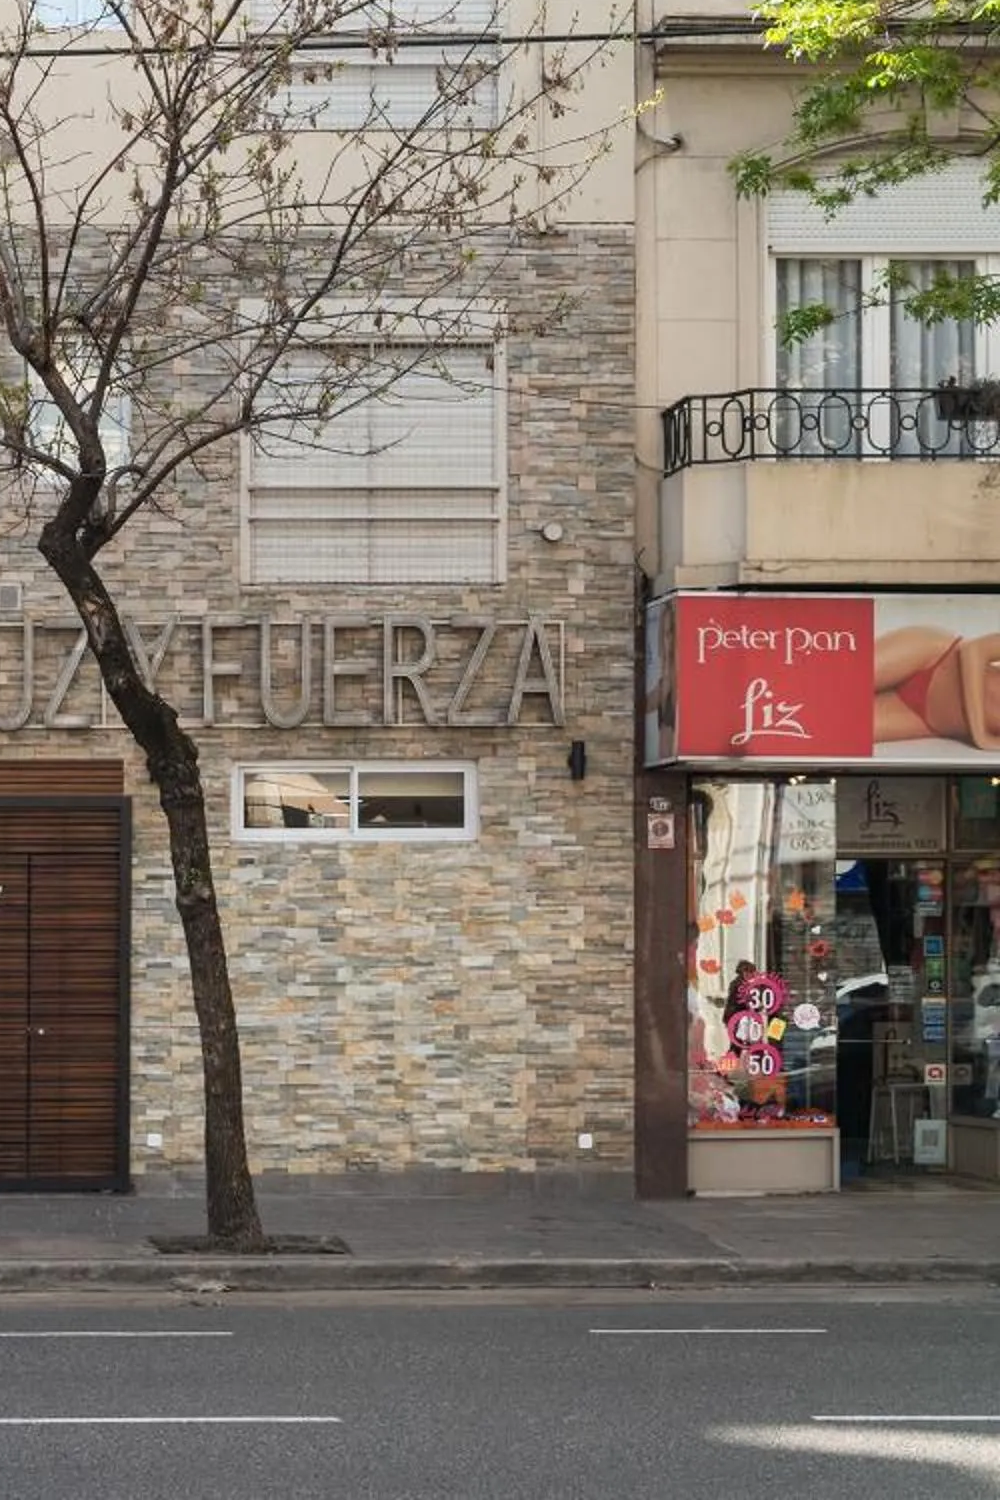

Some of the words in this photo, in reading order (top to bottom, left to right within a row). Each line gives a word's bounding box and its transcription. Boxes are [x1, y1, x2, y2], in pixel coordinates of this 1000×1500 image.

[203, 611, 566, 730] FUERZA
[749, 987, 774, 1009] 30
[748, 1054, 773, 1075] 50
